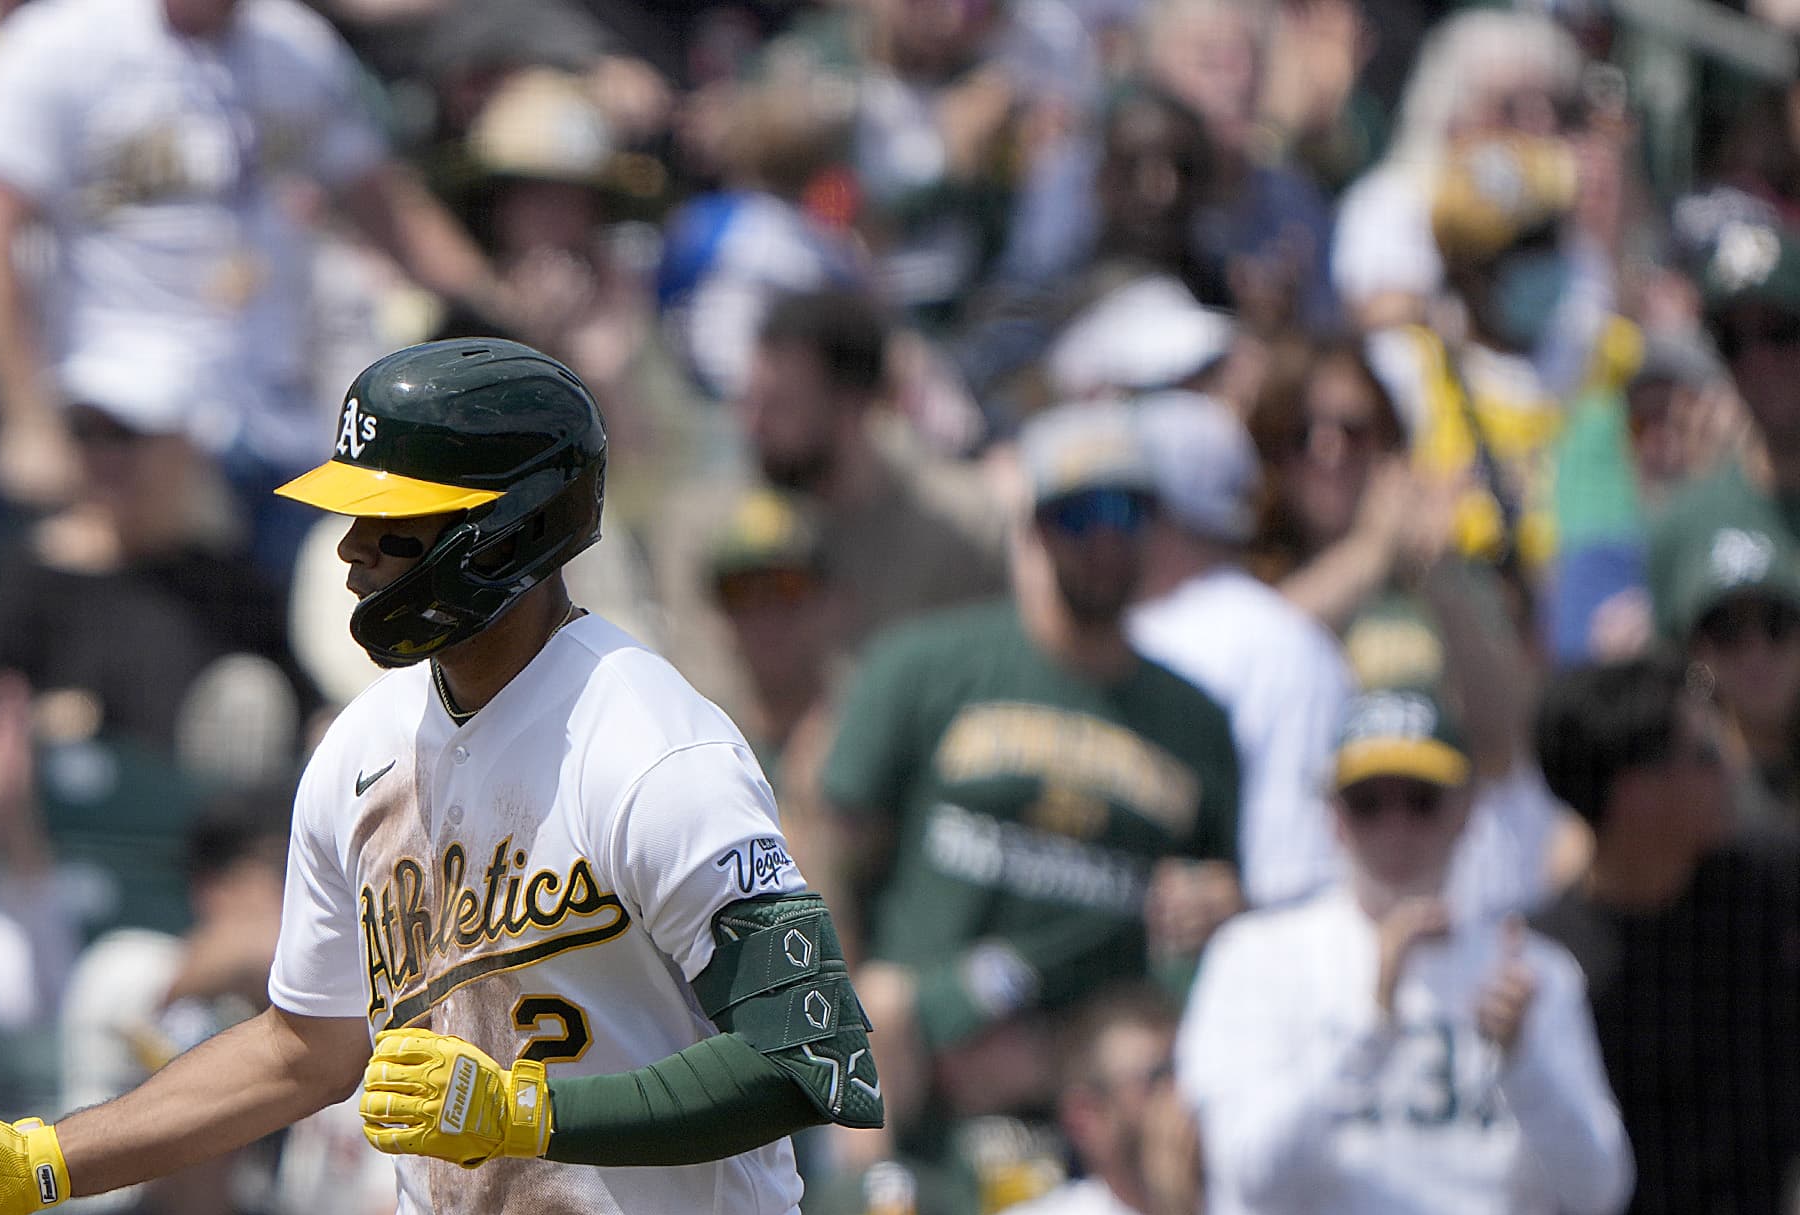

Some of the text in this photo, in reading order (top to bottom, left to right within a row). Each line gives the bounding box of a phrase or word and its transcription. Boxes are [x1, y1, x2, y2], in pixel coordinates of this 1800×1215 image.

[336, 397, 377, 459] A's
[717, 839, 792, 893] Vegas
[360, 834, 618, 1022] Athletics
[511, 994, 594, 1063] 2
